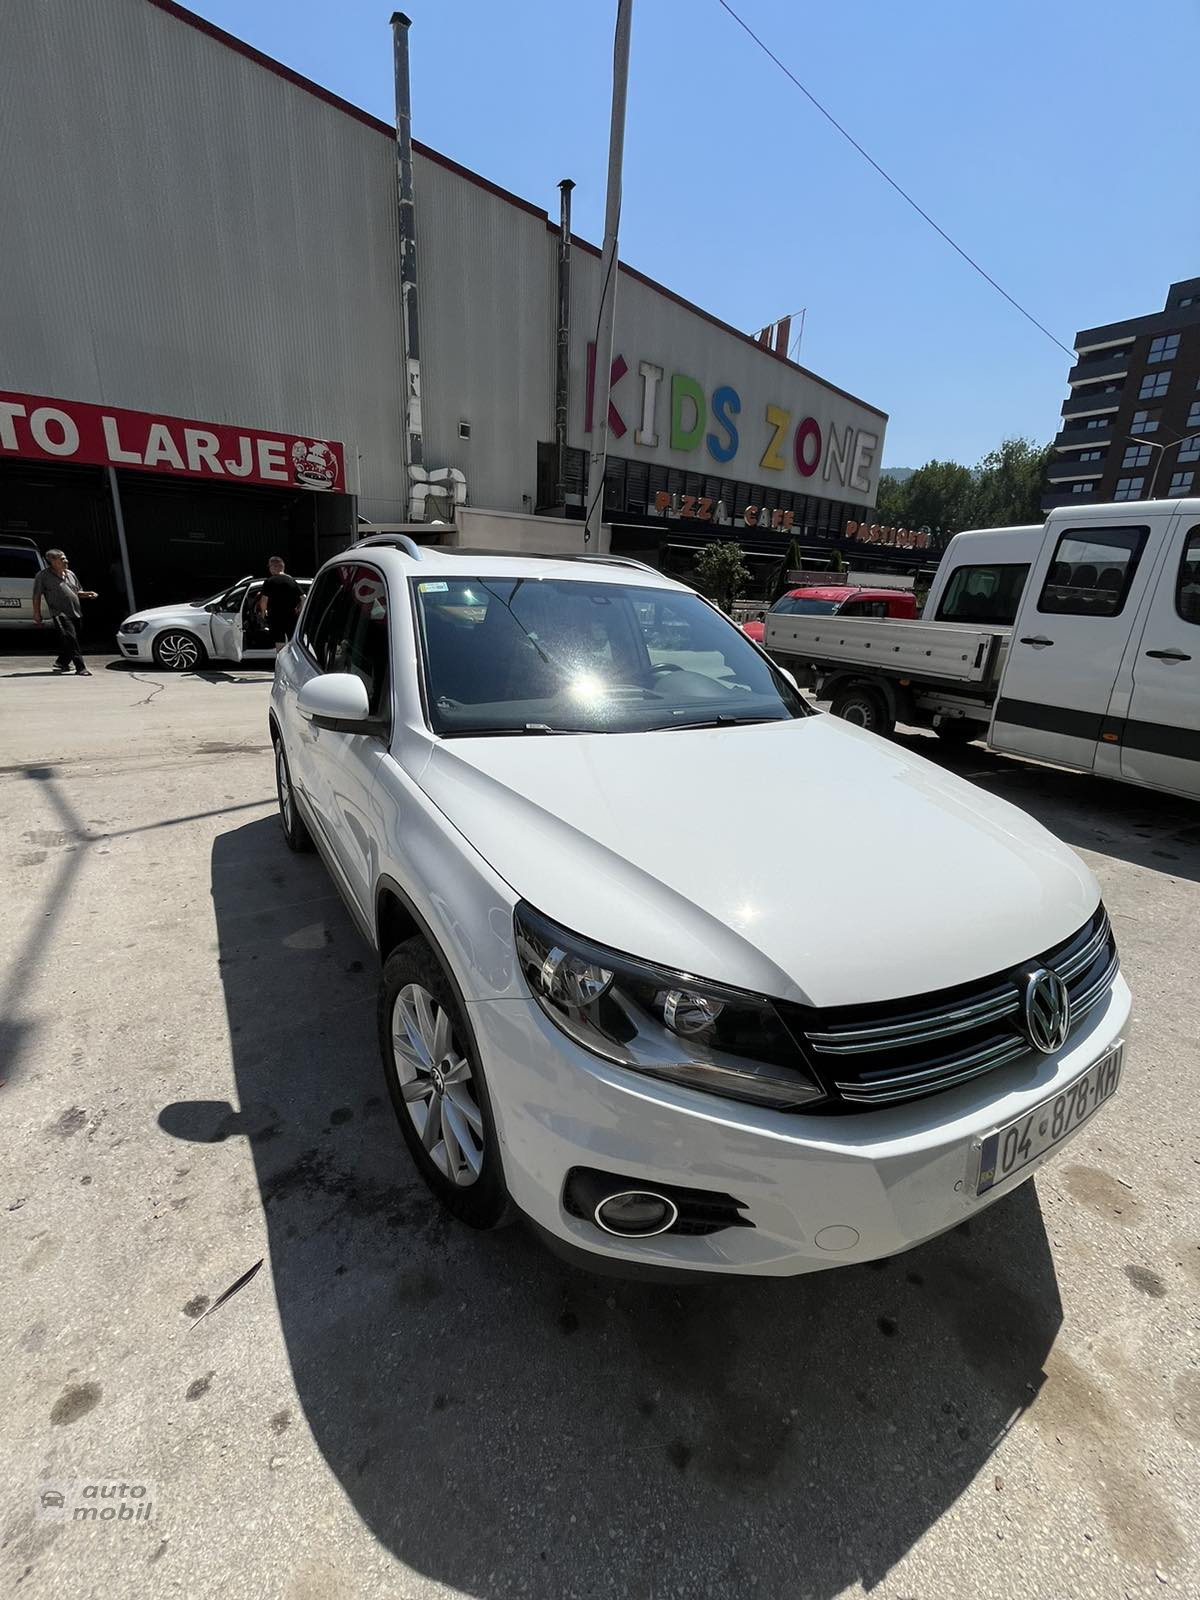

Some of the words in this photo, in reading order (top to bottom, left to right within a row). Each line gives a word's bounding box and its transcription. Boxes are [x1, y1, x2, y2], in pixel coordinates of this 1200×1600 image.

[102, 415, 289, 482] LARJE
[585, 342, 741, 463] KIDS
[760, 405, 878, 492] ZONE
[655, 489, 729, 523] PIZZA
[743, 504, 795, 533] CAFE
